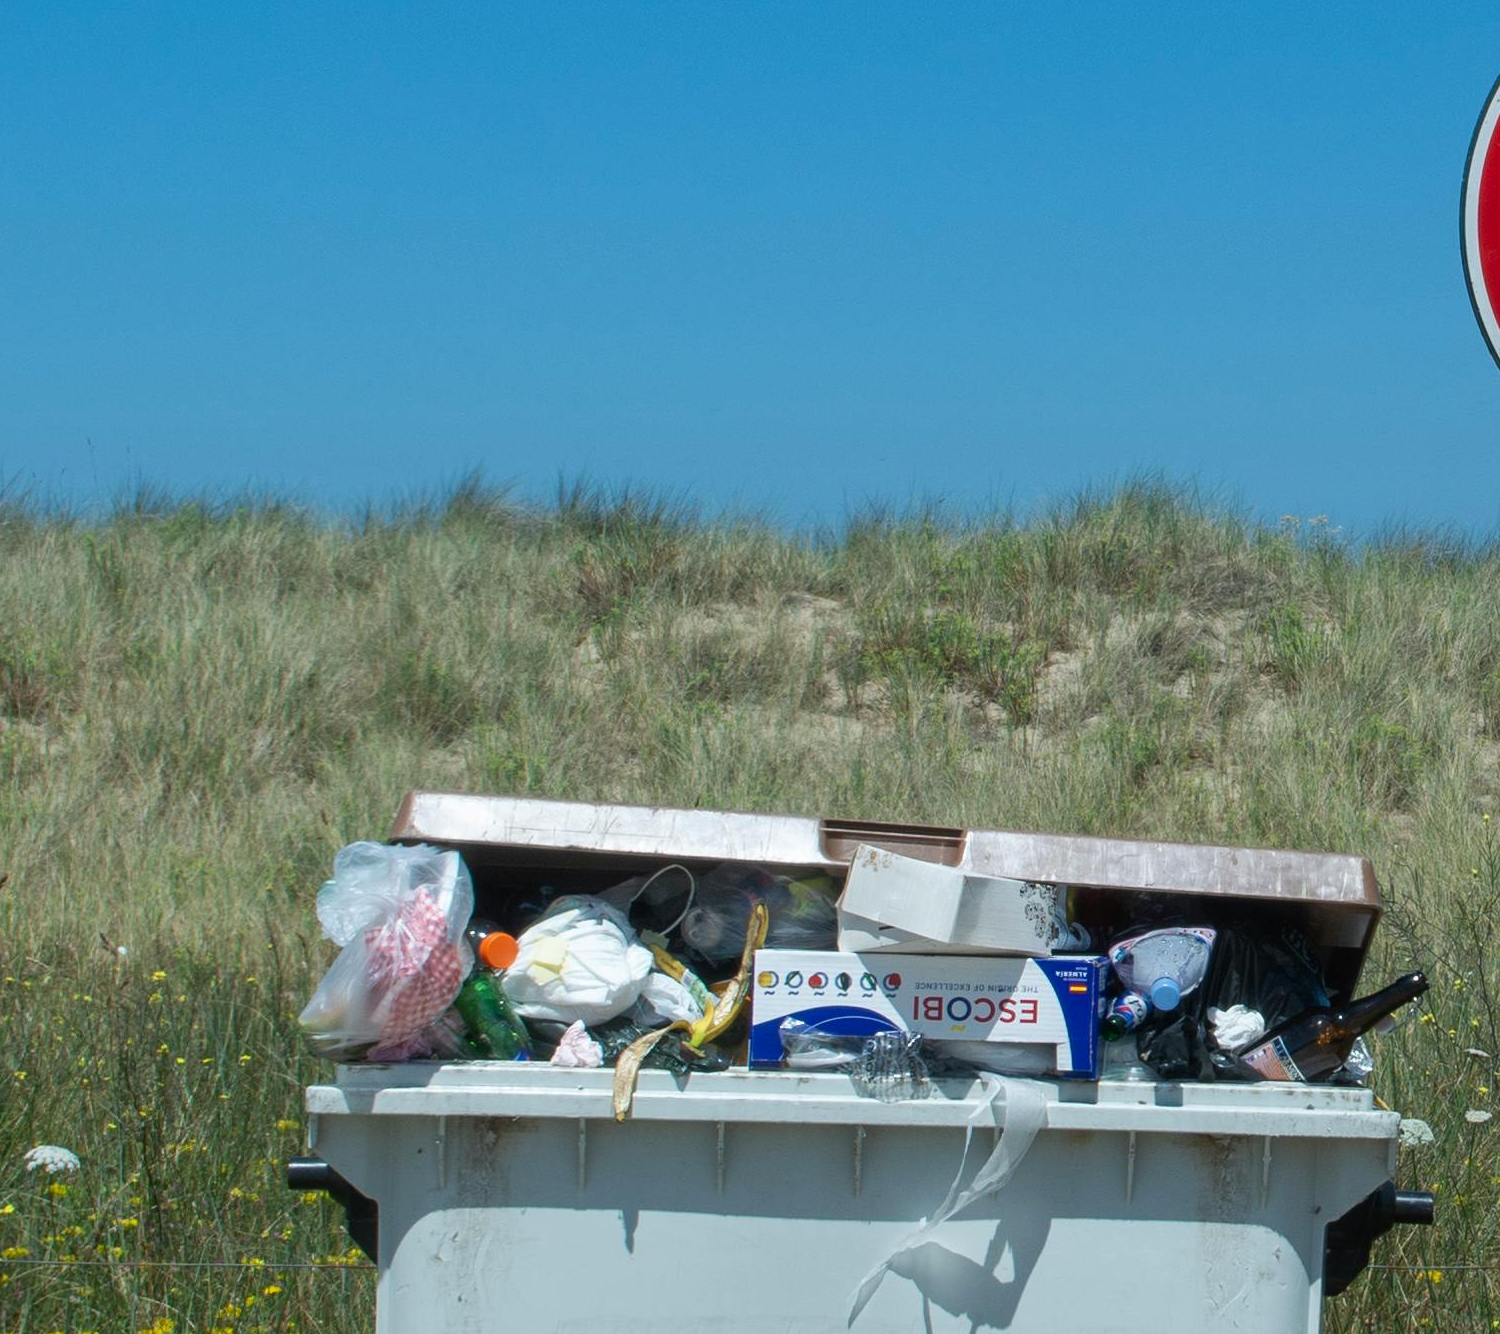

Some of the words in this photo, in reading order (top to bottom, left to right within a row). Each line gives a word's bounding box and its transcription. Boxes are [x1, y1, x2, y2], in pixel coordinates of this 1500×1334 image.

[915, 981, 970, 992] EXCELLENCE
[973, 983, 984, 992] OF
[987, 984, 1018, 993] ORIGIN
[1021, 985, 1038, 994] THE
